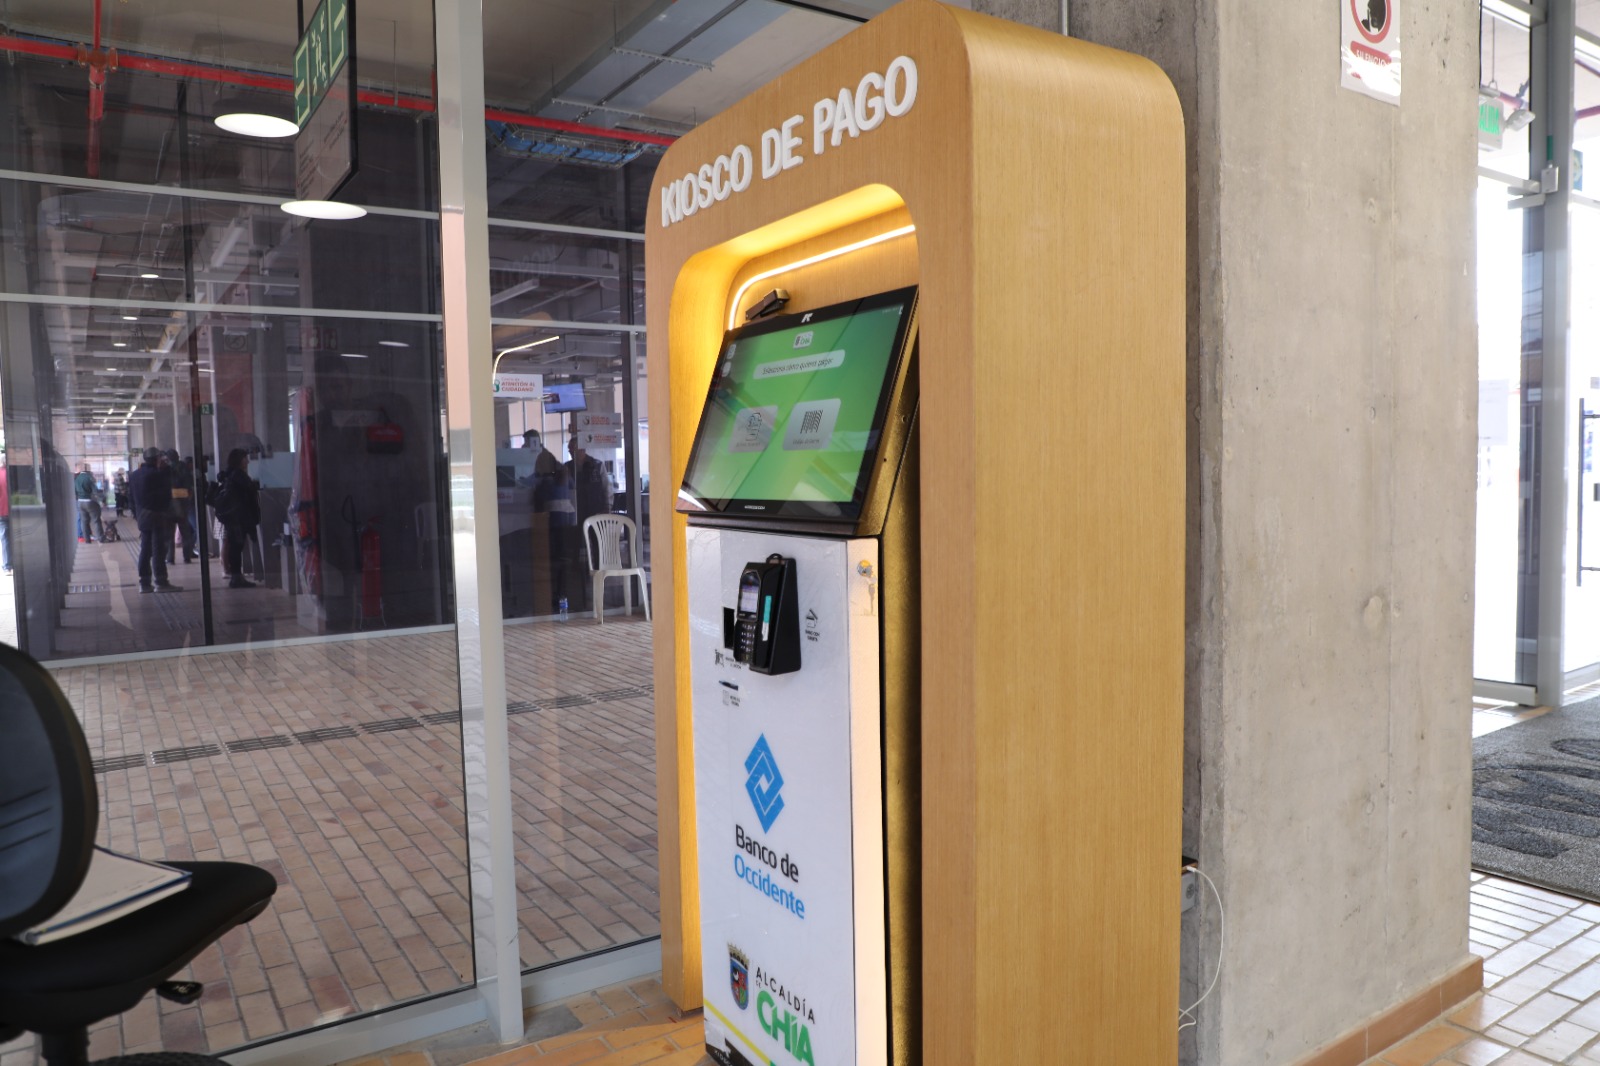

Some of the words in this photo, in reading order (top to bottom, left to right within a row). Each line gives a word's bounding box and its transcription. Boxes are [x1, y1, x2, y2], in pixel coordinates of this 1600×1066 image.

[661, 144, 753, 228] KIOSCO
[761, 114, 804, 180] DE
[813, 55, 918, 155] PAGO
[735, 824, 777, 869] Banco
[780, 853, 799, 883] de
[734, 854, 805, 920] Occidente
[756, 966, 816, 1025] ALCALDÍA
